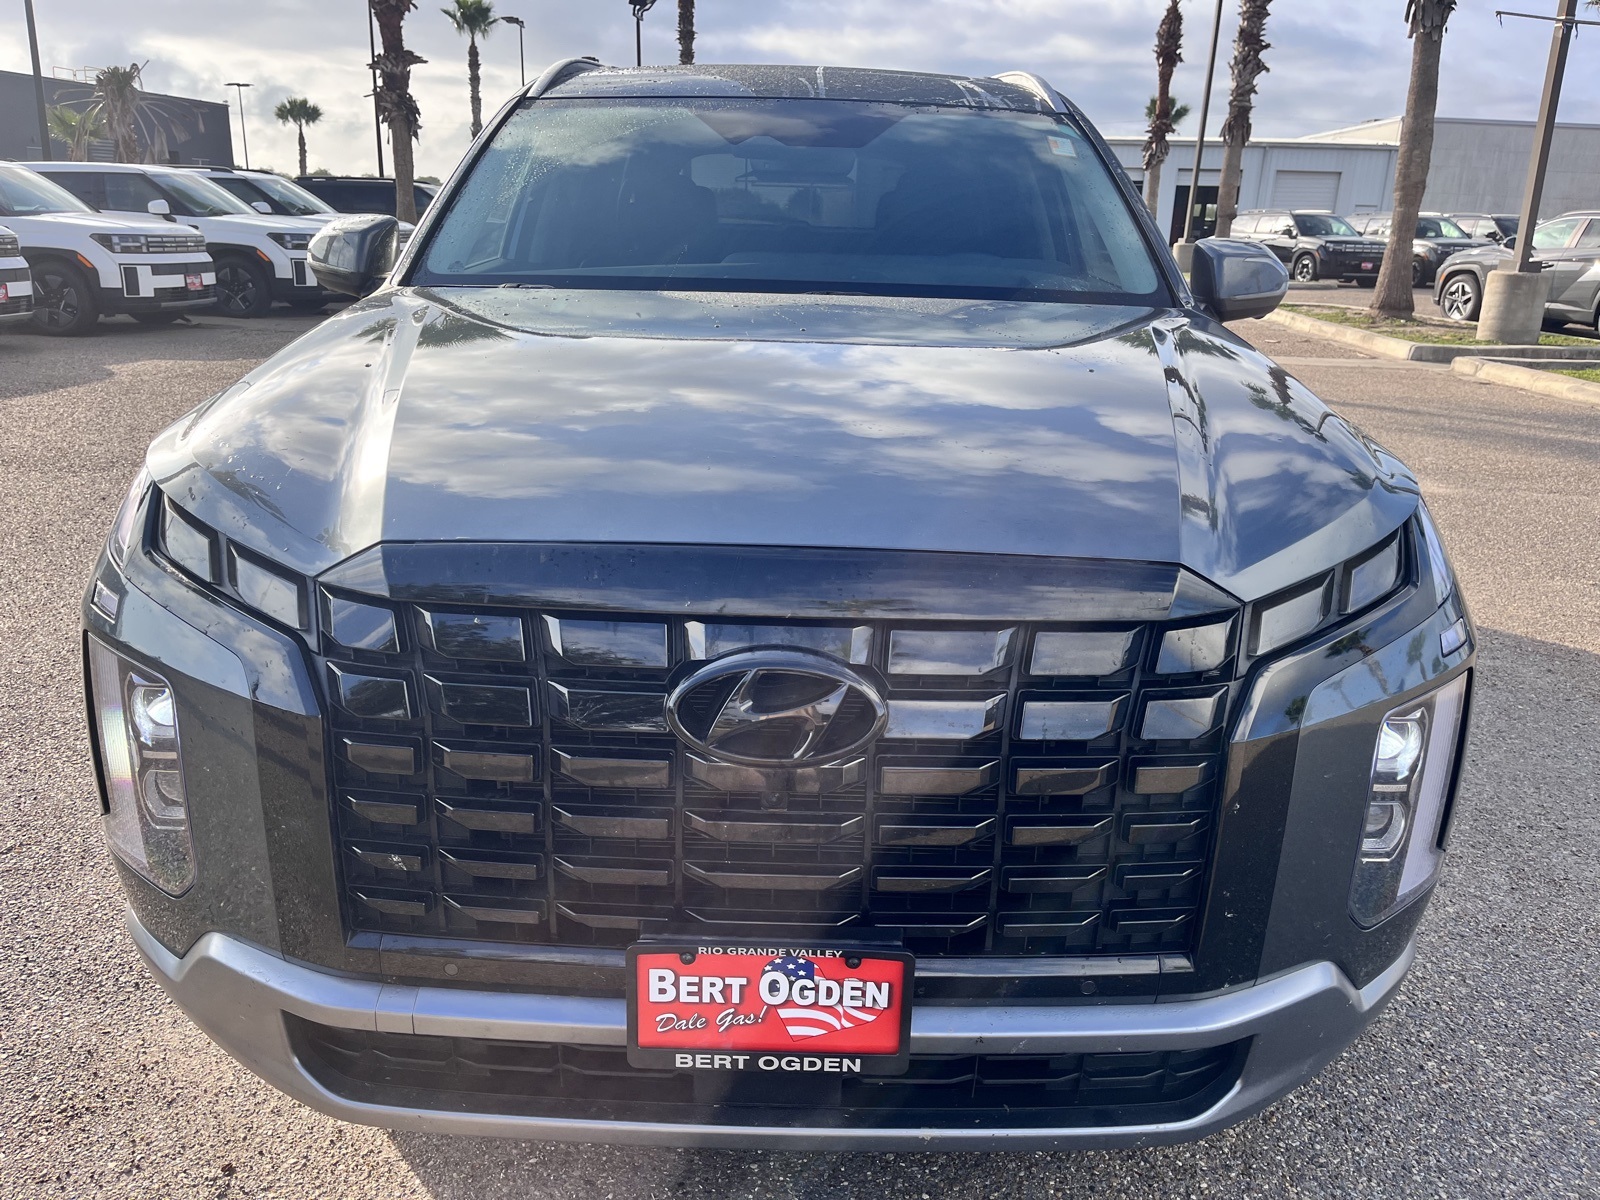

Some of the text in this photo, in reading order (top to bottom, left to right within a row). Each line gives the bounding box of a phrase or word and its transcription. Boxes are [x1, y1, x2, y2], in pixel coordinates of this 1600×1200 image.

[698, 947, 843, 958] RIO GRANDE VALLEY
[648, 968, 889, 1008] BERT OGDEN
[655, 1005, 768, 1033] Dale Gas!
[675, 1053, 861, 1073] BERT OGDEN
